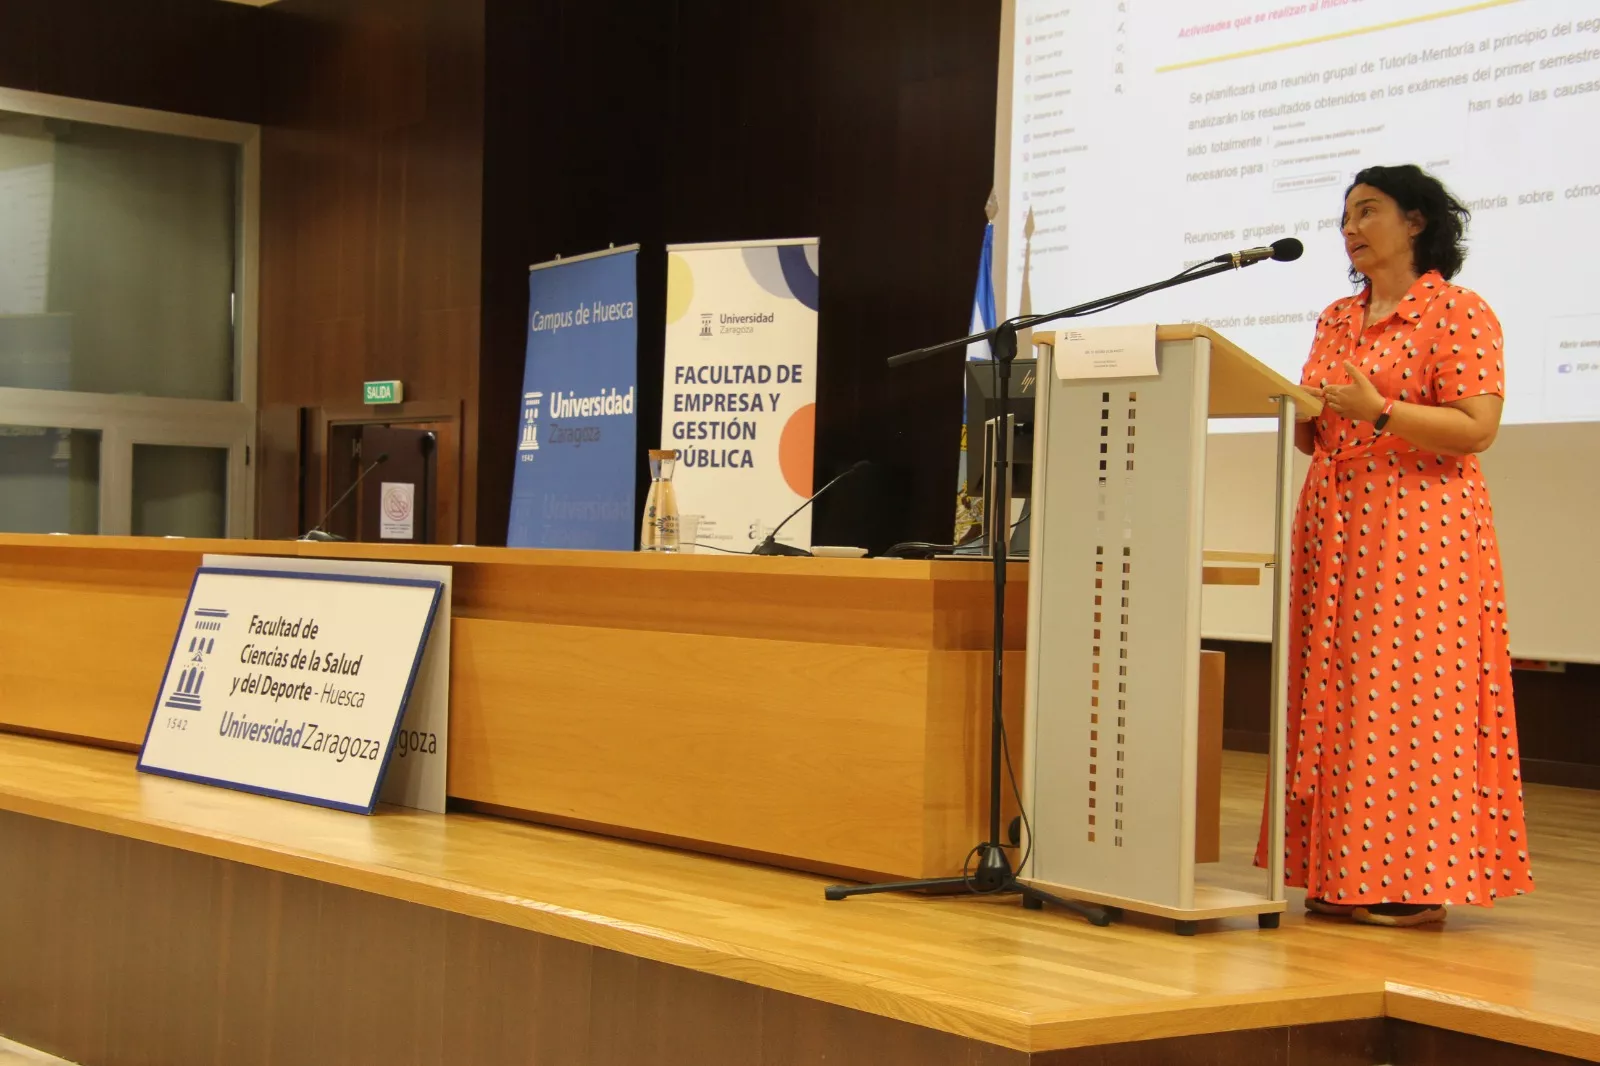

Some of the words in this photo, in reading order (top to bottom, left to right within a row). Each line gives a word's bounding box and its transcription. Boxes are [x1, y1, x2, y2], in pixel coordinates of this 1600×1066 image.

[1178, 20, 1231, 38] Actividades
[1234, 15, 1252, 31] que
[1255, 13, 1266, 24] se
[1268, 4, 1306, 20] realizan
[1309, 1, 1319, 12] al
[1189, 91, 1202, 105] Se
[1205, 83, 1256, 105] planificará
[1259, 79, 1278, 92] una
[1281, 69, 1319, 88] reunión
[1323, 63, 1357, 84] grupal
[1361, 60, 1375, 74] de
[1379, 41, 1475, 71] Tutoría-Mentoría
[1479, 38, 1490, 53] al
[1494, 27, 1548, 52] principio
[1552, 21, 1572, 38] del
[1576, 17, 1600, 33] seg
[1188, 112, 1238, 131] analizarán
[1241, 109, 1256, 122] los
[1258, 97, 1312, 119] resultados
[1314, 90, 1367, 111] obtenidos
[1370, 88, 1385, 100] en
[1388, 84, 1404, 98] los
[1408, 72, 1469, 94] exámenes
[1472, 68, 1490, 83] del
[1494, 60, 1536, 81] primer
[1539, 48, 1600, 71] semestre
[1468, 99, 1491, 114] han
[1496, 93, 1523, 109] sido
[1529, 88, 1548, 103] las
[1553, 80, 1600, 99] causas
[1187, 143, 1207, 157] sido
[1211, 135, 1262, 153] totalmente
[1186, 167, 1238, 182] necesarios
[1240, 163, 1263, 179] para
[1461, 194, 1508, 210] entoría
[1518, 190, 1555, 205] sobre
[1564, 183, 1600, 199] cómo
[1184, 229, 1236, 245] Reuniones
[1242, 223, 1286, 240] grupales
[1294, 218, 1310, 235] y/o
[532, 310, 573, 334] Campus
[575, 302, 590, 325] de
[593, 300, 634, 323] Huesca
[720, 311, 775, 325] Universidad
[720, 325, 754, 336] Zaragoza
[1244, 314, 1257, 327] de
[1259, 310, 1304, 326] sesiones
[674, 364, 772, 385] FACULTAD
[776, 364, 803, 384] DE
[366, 386, 392, 400] SALIDA
[550, 386, 634, 419] Universidad
[673, 392, 764, 413] EMPRESA
[768, 392, 781, 413] Y
[548, 423, 601, 448] Zaragoza
[672, 416, 757, 441] GESTIÓN
[248, 614, 301, 639] Facultad
[302, 617, 319, 641] de
[240, 643, 289, 668] Ciencias
[290, 647, 308, 670] de
[308, 649, 320, 672] la
[322, 652, 363, 677] Salud
[229, 676, 239, 697] y
[240, 672, 261, 695] del
[261, 674, 312, 702] Deporte
[320, 682, 366, 709] Huesca
[166, 716, 188, 731] 1542
[398, 729, 437, 758] goza
